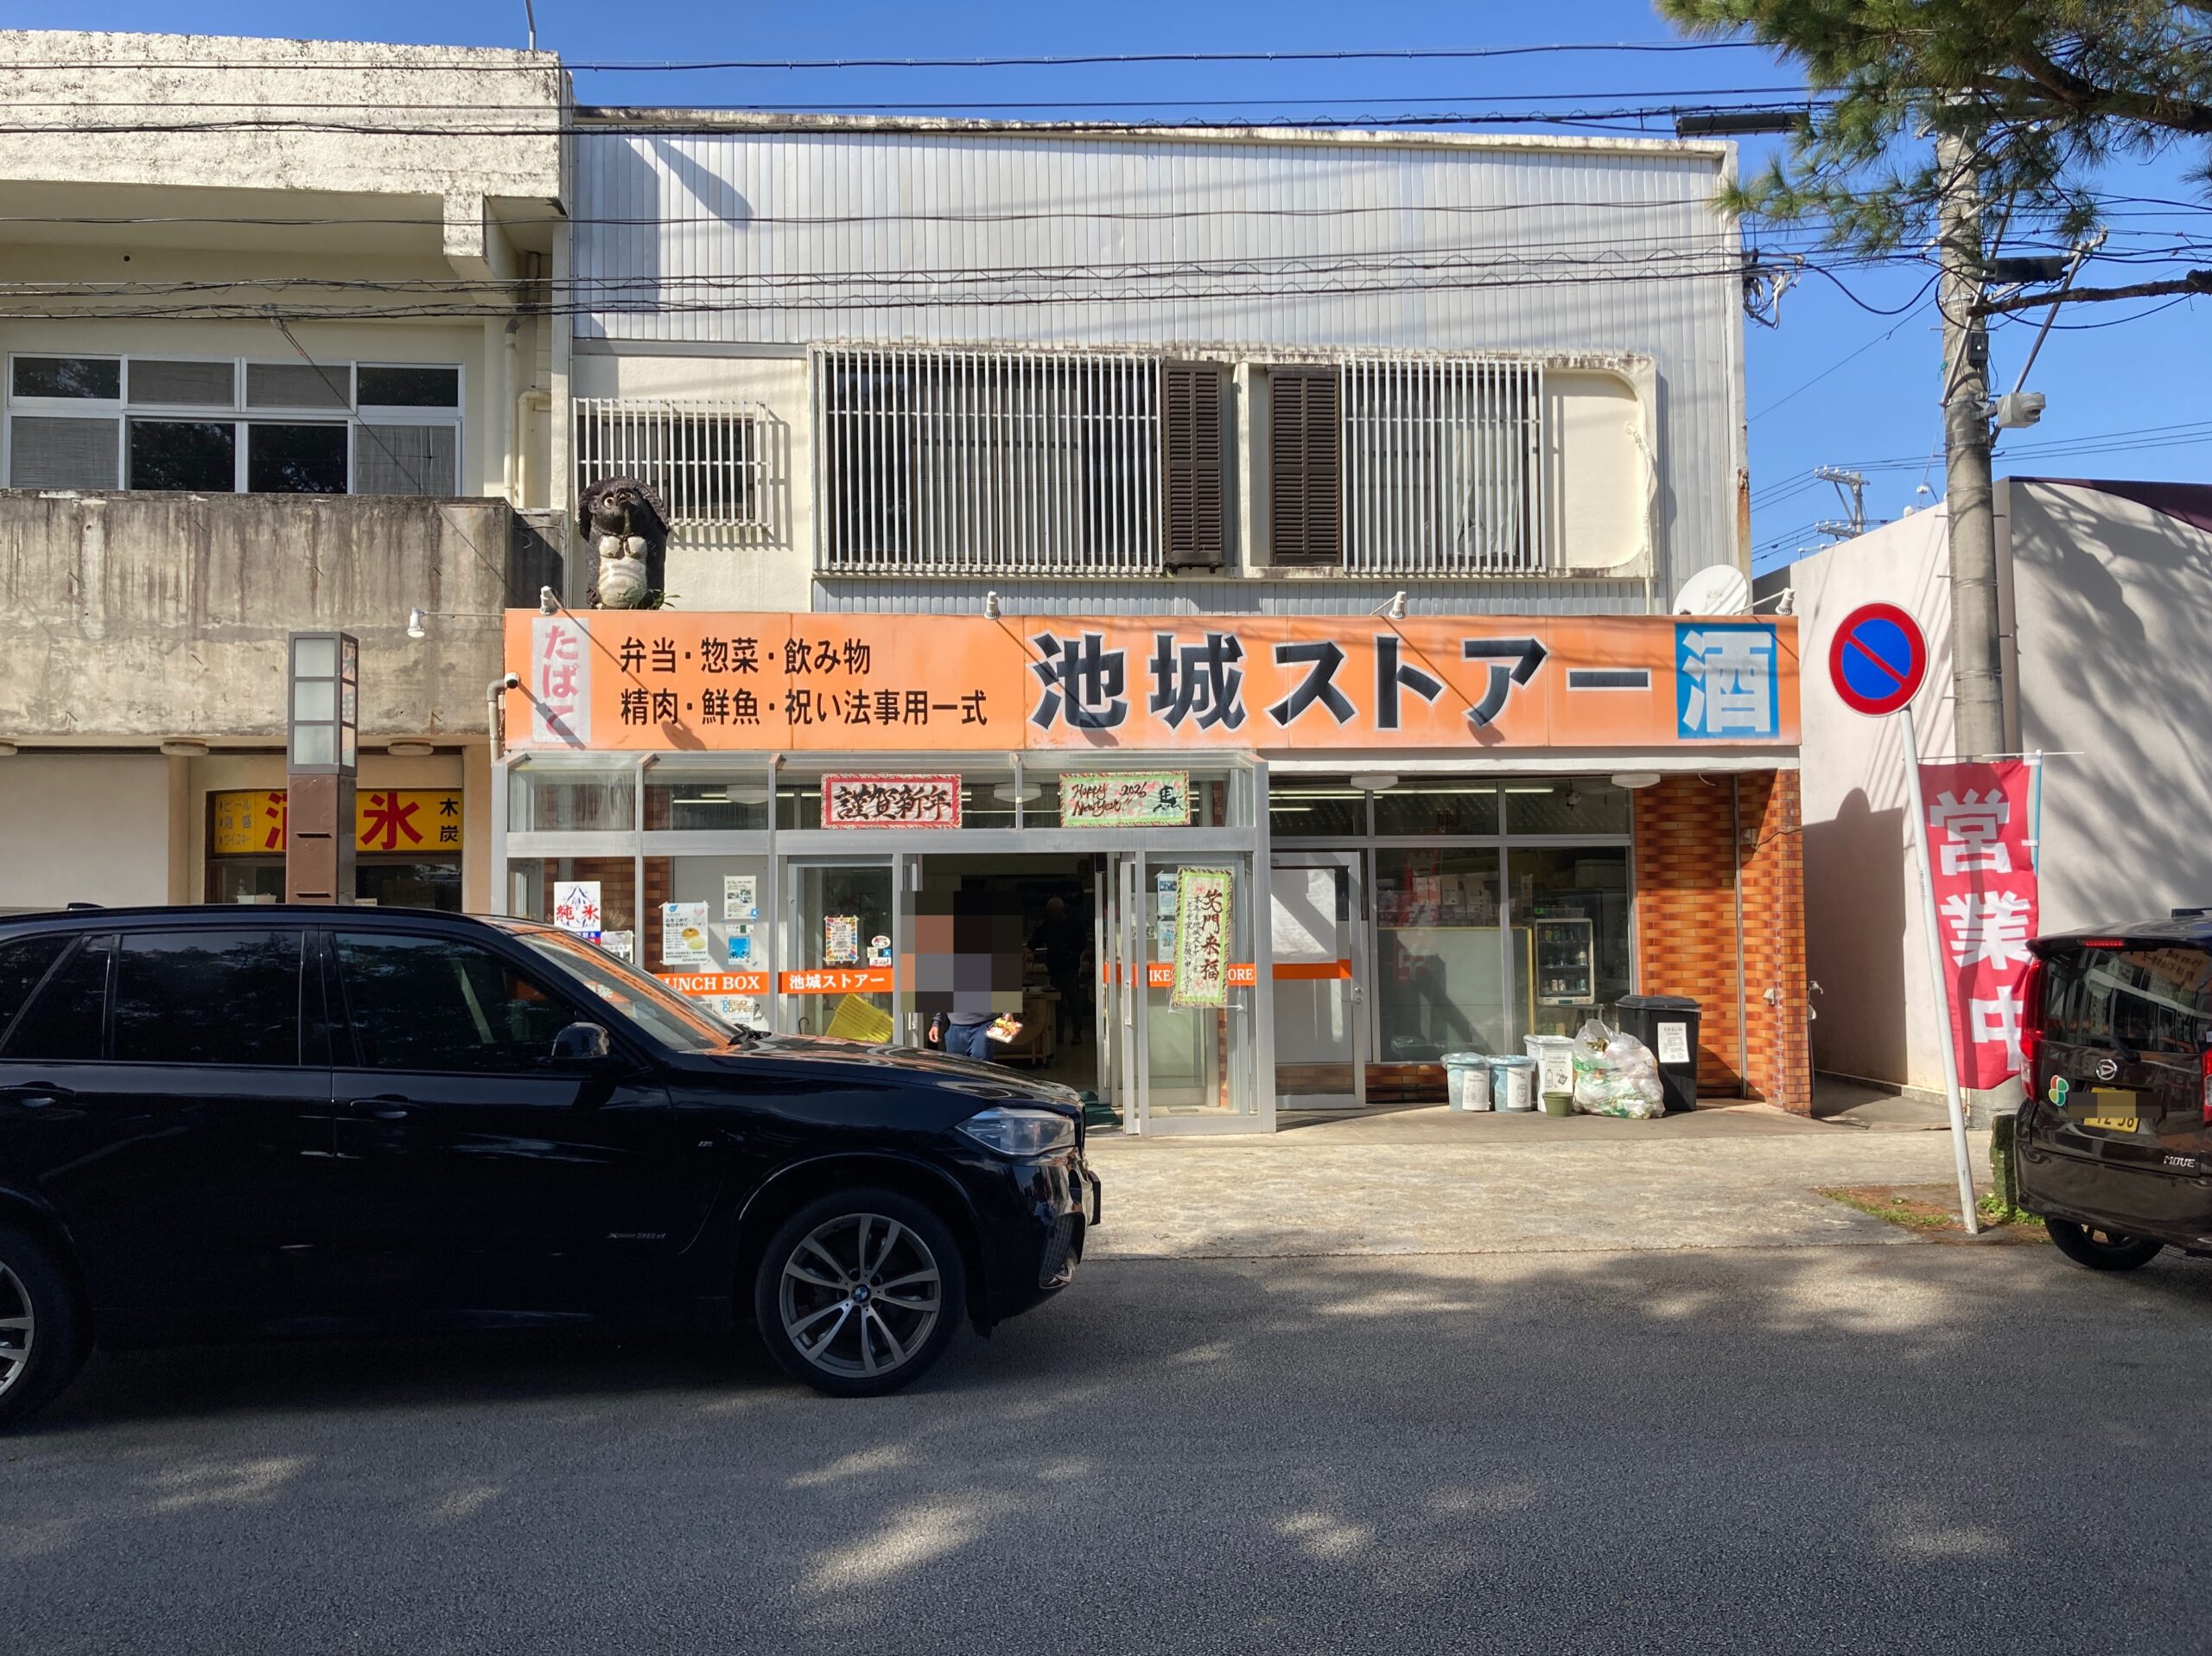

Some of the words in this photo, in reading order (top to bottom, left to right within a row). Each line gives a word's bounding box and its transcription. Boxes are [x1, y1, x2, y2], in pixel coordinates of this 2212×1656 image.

[620, 636, 871, 675] 弁当・惣菜・飲み物
[543, 625, 579, 739] たばこ
[1028, 631, 1651, 731] 池城ストアー
[1682, 629, 1773, 733] 酒
[620, 687, 988, 726] 精肉・鮮魚・祝い法事用一式
[833, 783, 952, 821] 謹賀新年
[1071, 783, 1108, 800] Happy
[1120, 781, 1147, 797] 2026
[1153, 784, 1183, 812] 馬
[360, 792, 423, 850] 氷
[439, 798, 459, 843] 木炭
[1200, 889, 1223, 981] 笑門来福
[1929, 787, 2031, 1072] 営業中
[664, 978, 717, 991] UNCH
[722, 976, 760, 990] BOX
[789, 973, 885, 990] 池城ストアー
[2163, 1155, 2196, 1168] MOVE
